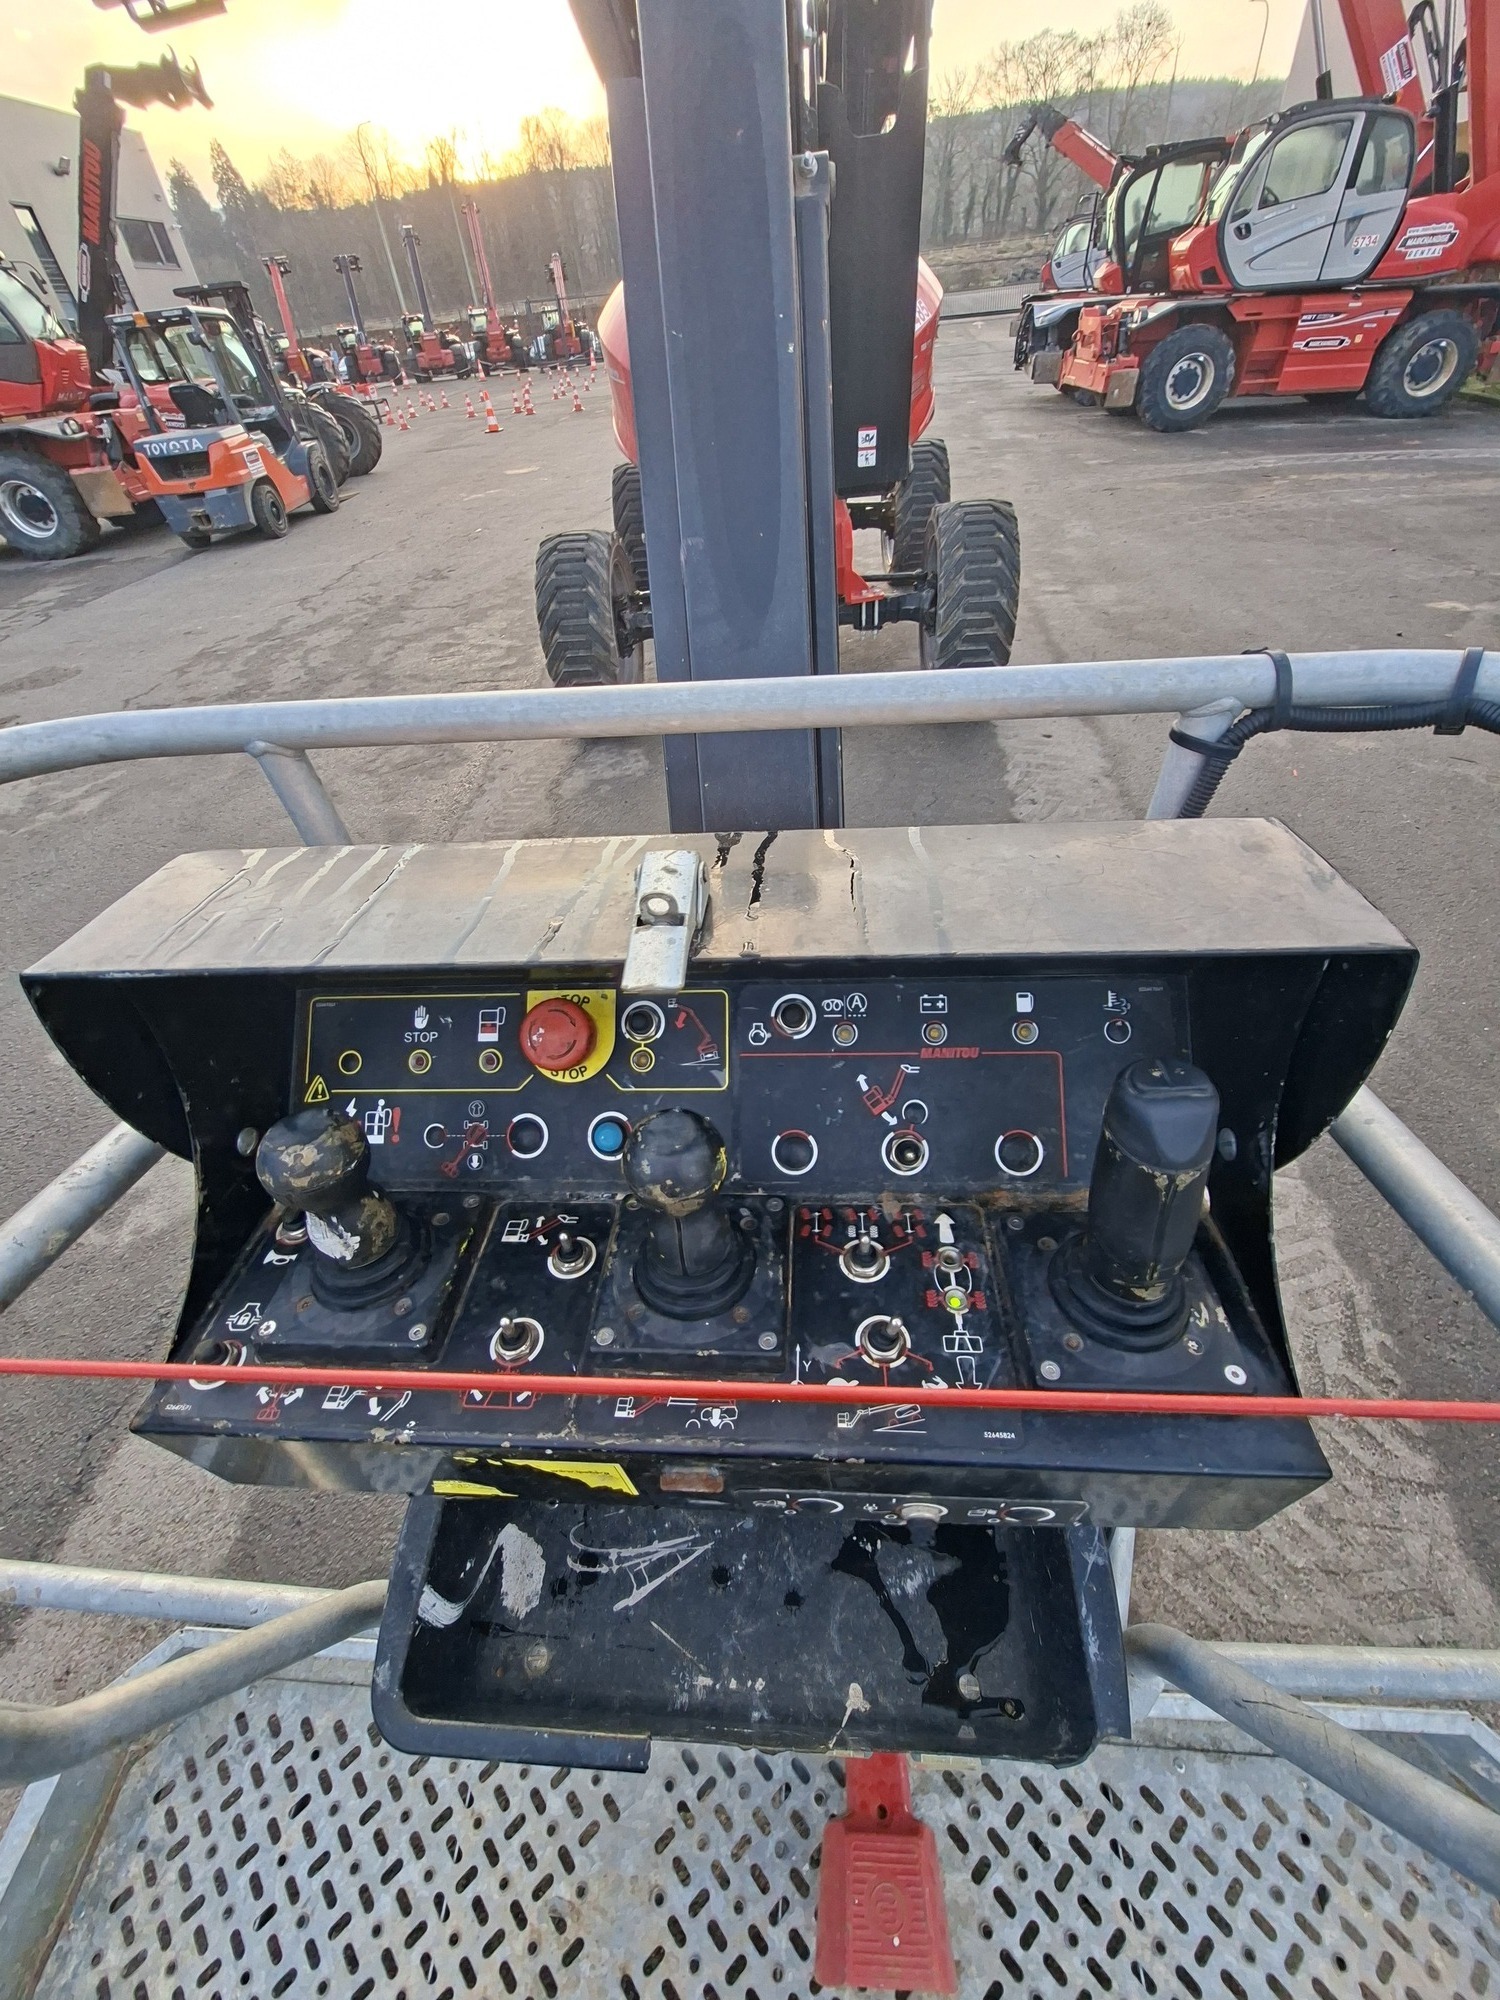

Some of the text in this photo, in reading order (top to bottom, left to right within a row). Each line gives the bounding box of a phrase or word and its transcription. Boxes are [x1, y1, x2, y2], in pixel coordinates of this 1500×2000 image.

[82, 137, 101, 245] MANITOU
[1353, 236, 1378, 247] 5734
[1407, 248, 1442, 258] RENTAL
[143, 438, 204, 456] TOYOTA
[404, 1032, 438, 1043] STOP
[920, 1047, 980, 1059] MANITOU
[802, 1360, 812, 1372] Y
